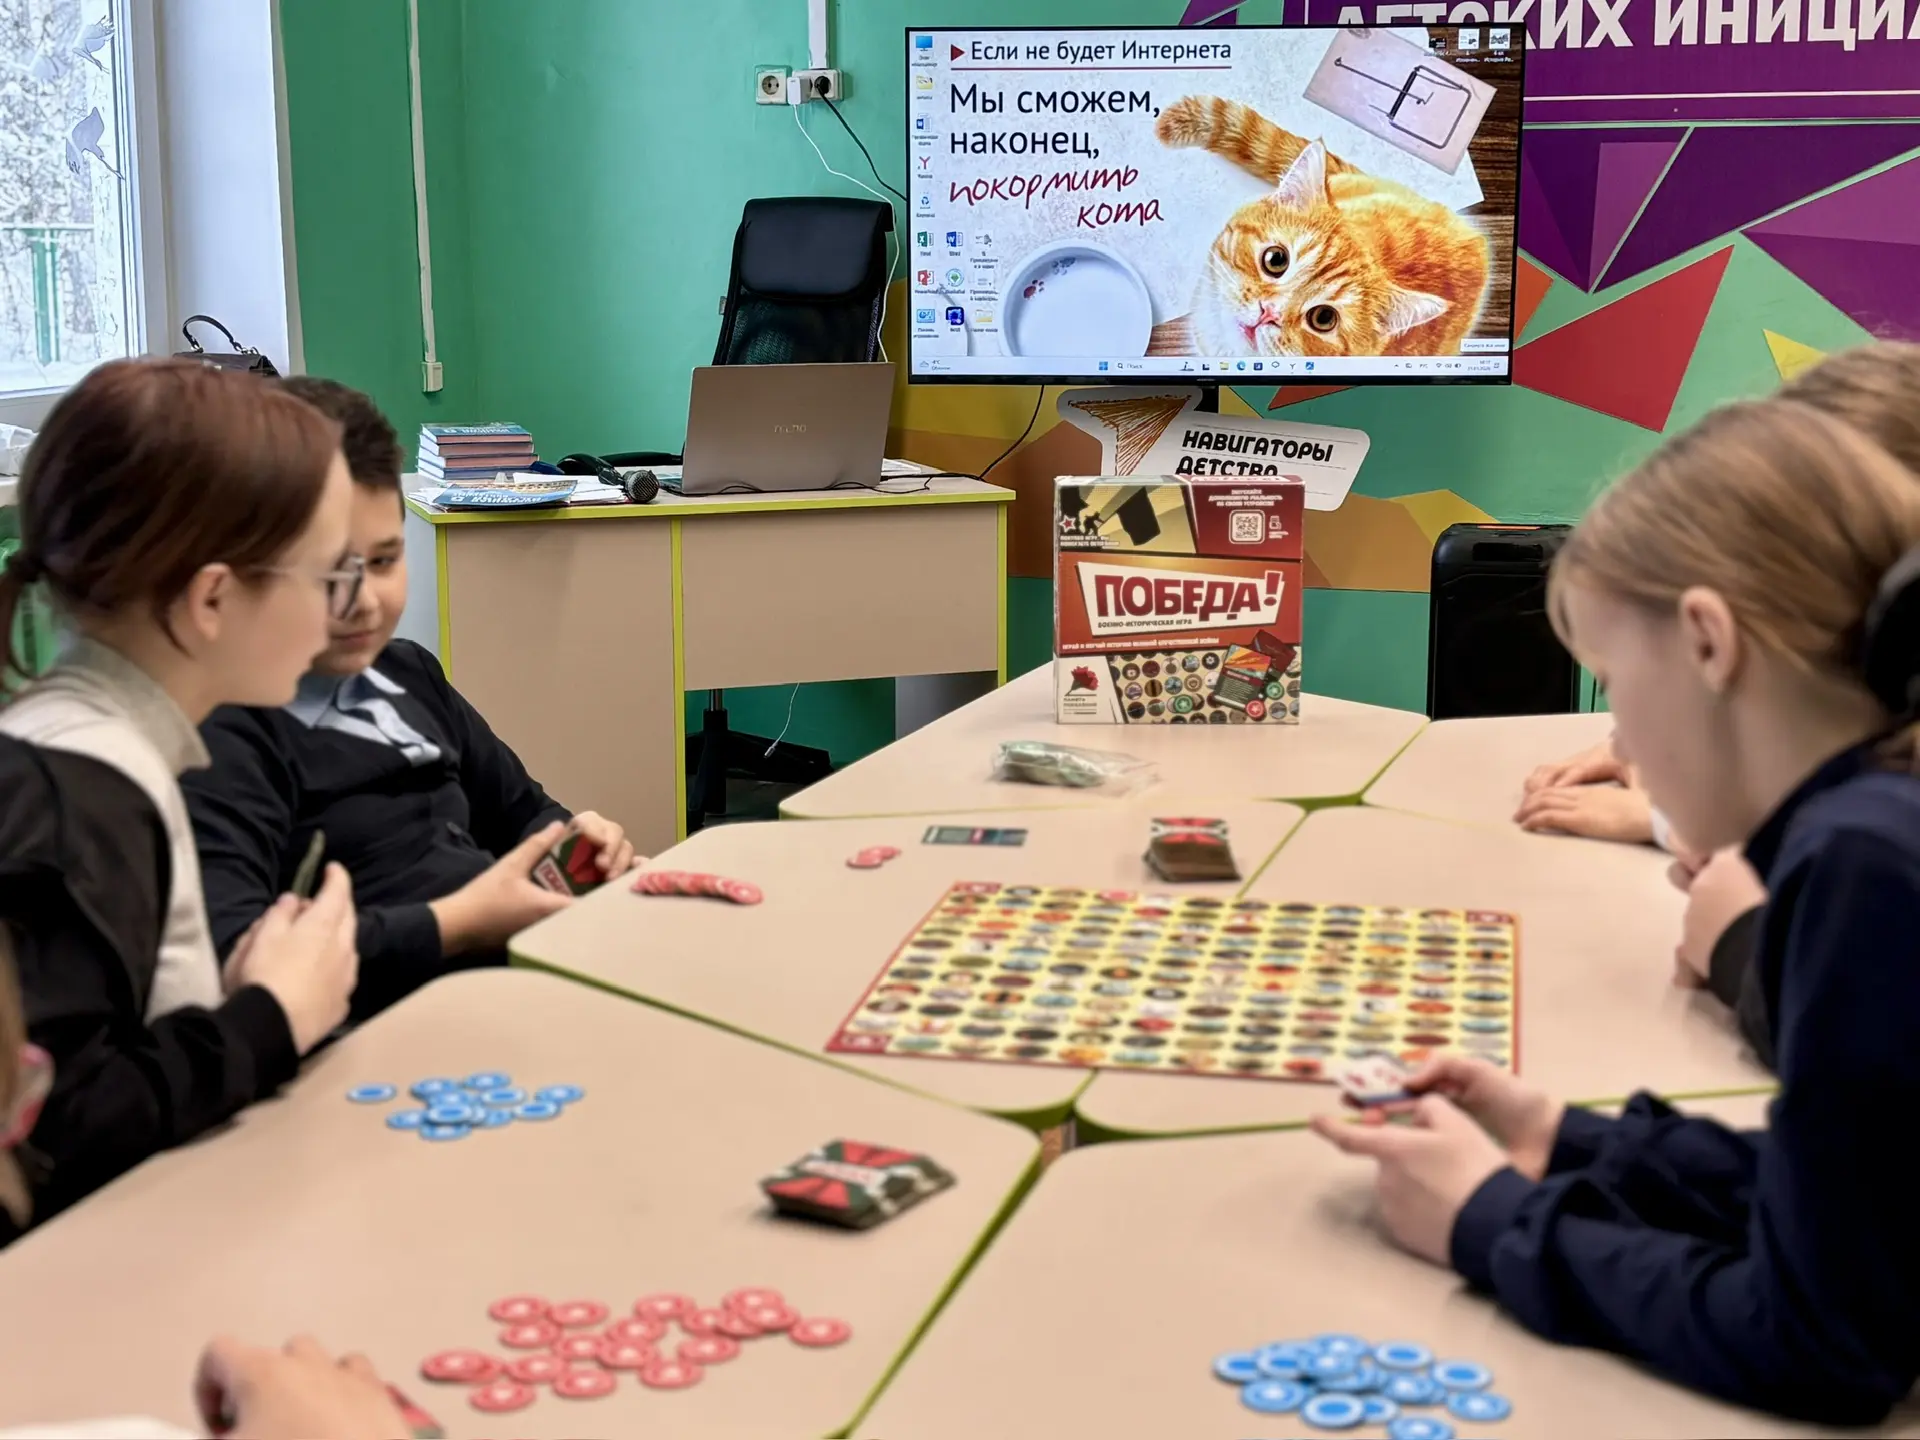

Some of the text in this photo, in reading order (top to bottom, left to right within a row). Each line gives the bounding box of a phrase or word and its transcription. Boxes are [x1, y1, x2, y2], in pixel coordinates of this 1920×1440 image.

[1653, 0, 1920, 51] ИНИЦИ
[971, 40, 1232, 64] Если не будет Интернета
[950, 83, 1160, 118] Мы сможем,
[950, 131, 1100, 159] наконец,
[949, 165, 1139, 210] покормить
[1076, 199, 1164, 229] кота
[1182, 430, 1334, 462] НАВИГАТОРЫ
[1094, 571, 1282, 622] ПОБЕДА!
